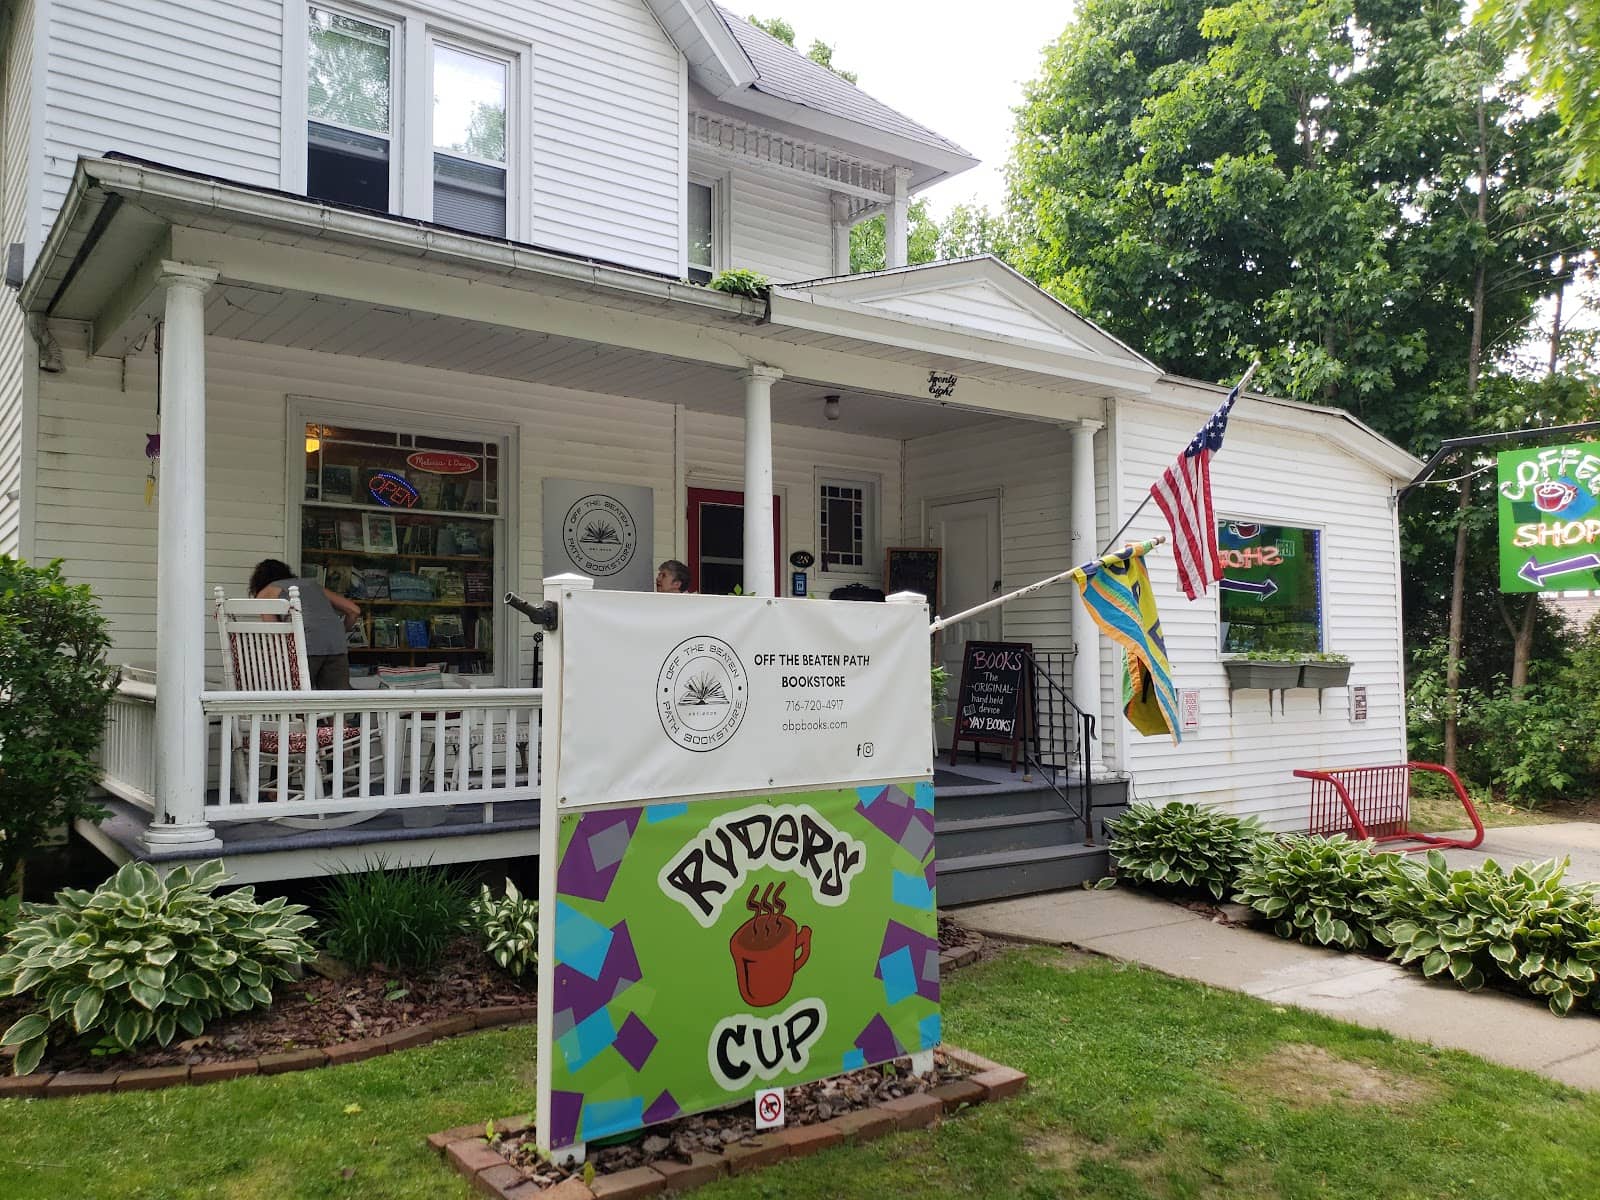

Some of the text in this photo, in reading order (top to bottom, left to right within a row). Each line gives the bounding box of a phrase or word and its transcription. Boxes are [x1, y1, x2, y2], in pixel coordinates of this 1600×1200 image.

[929, 385, 953, 398] Eight
[368, 475, 420, 509] OPEN
[570, 500, 630, 527] OFF THE BEATEN
[1513, 519, 1600, 548] SHOP
[567, 537, 632, 572] PATH BOOKSTORE
[796, 554, 810, 565] 28
[665, 643, 740, 680] OFF THE BEATEN
[754, 654, 870, 667] OFF THE BEATEN PATH
[974, 651, 1022, 671] BOOKS
[781, 675, 846, 688] BOOKSTORE
[983, 671, 998, 682] The
[974, 682, 1013, 694] ORIGINAL
[785, 699, 844, 712] 716-720-4917
[978, 703, 1001, 714] device
[662, 700, 742, 745] PATH BOOKSTORE
[782, 717, 848, 734] obpbooks.com
[968, 716, 985, 729] YAY
[716, 1007, 820, 1080] CUP
